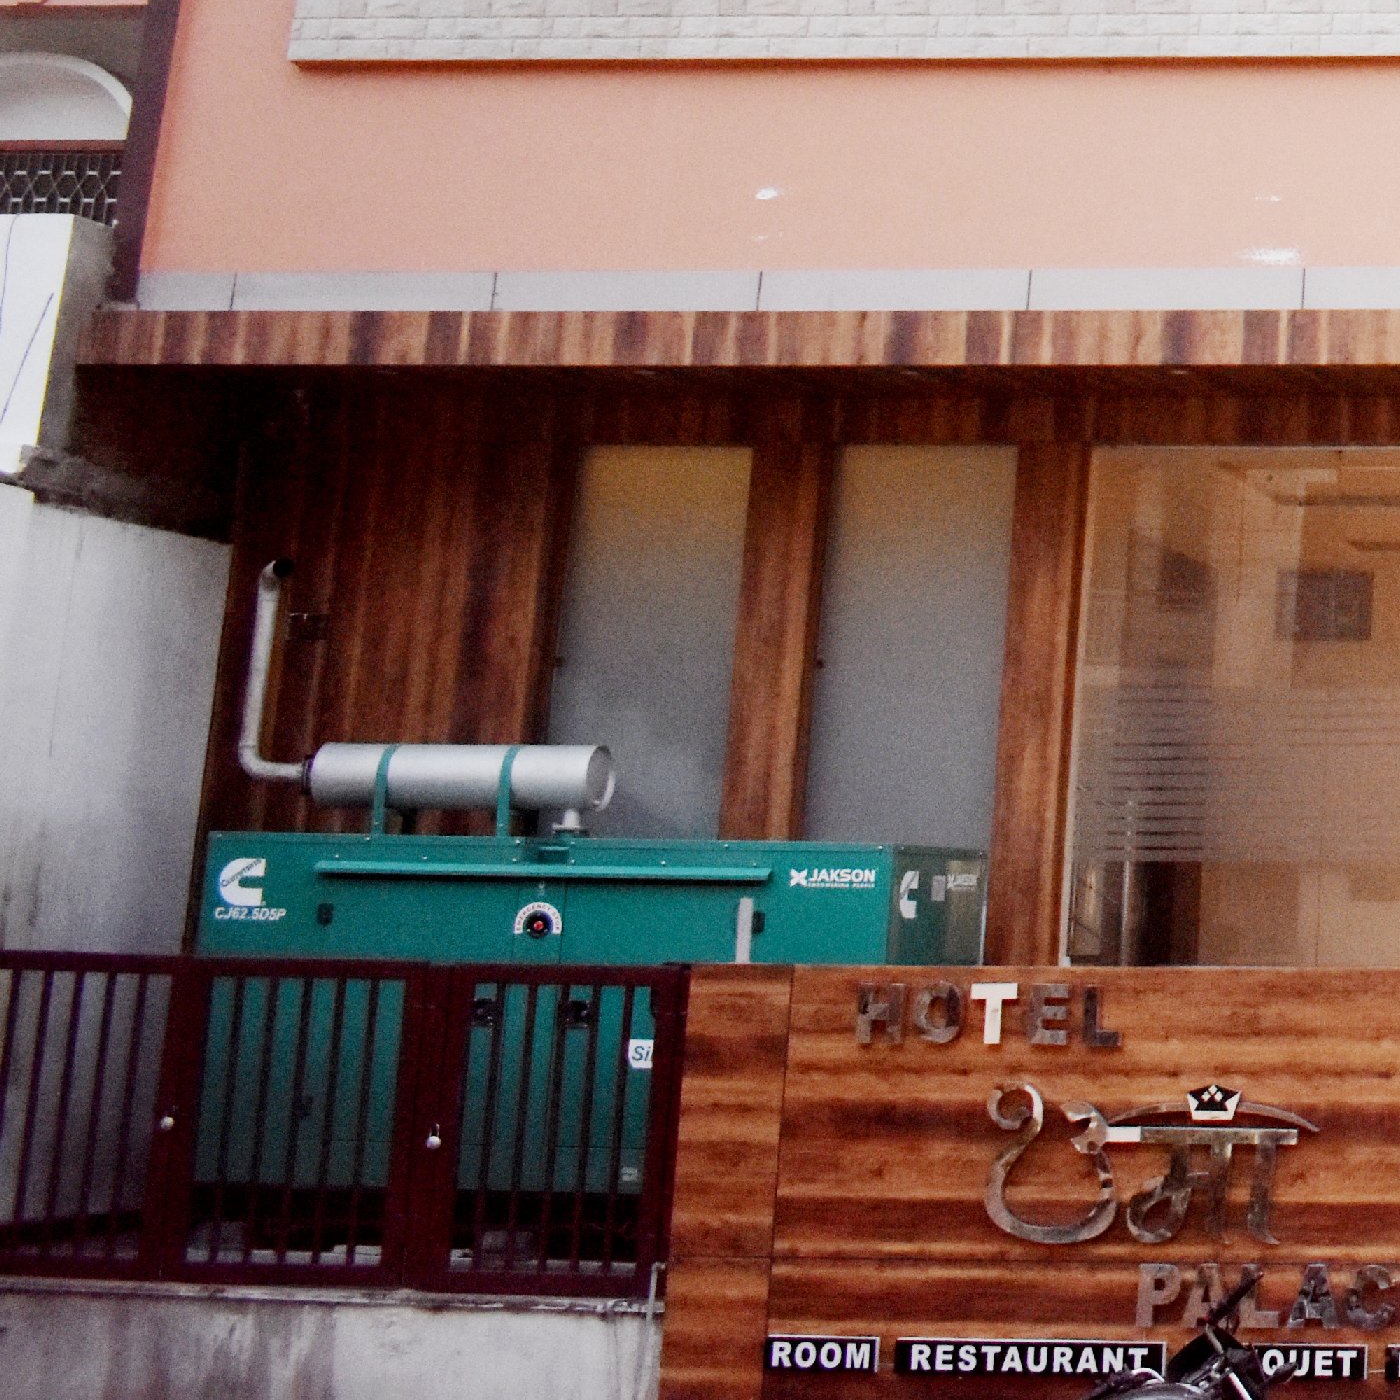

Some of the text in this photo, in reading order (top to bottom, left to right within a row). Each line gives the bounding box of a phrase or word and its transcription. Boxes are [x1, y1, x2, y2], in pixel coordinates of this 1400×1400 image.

[808, 868, 876, 882] JAKSON
[856, 982, 1121, 1047] HOTEL
[770, 1341, 871, 1369] ROOM
[909, 1343, 1150, 1374] RESTAURANT
